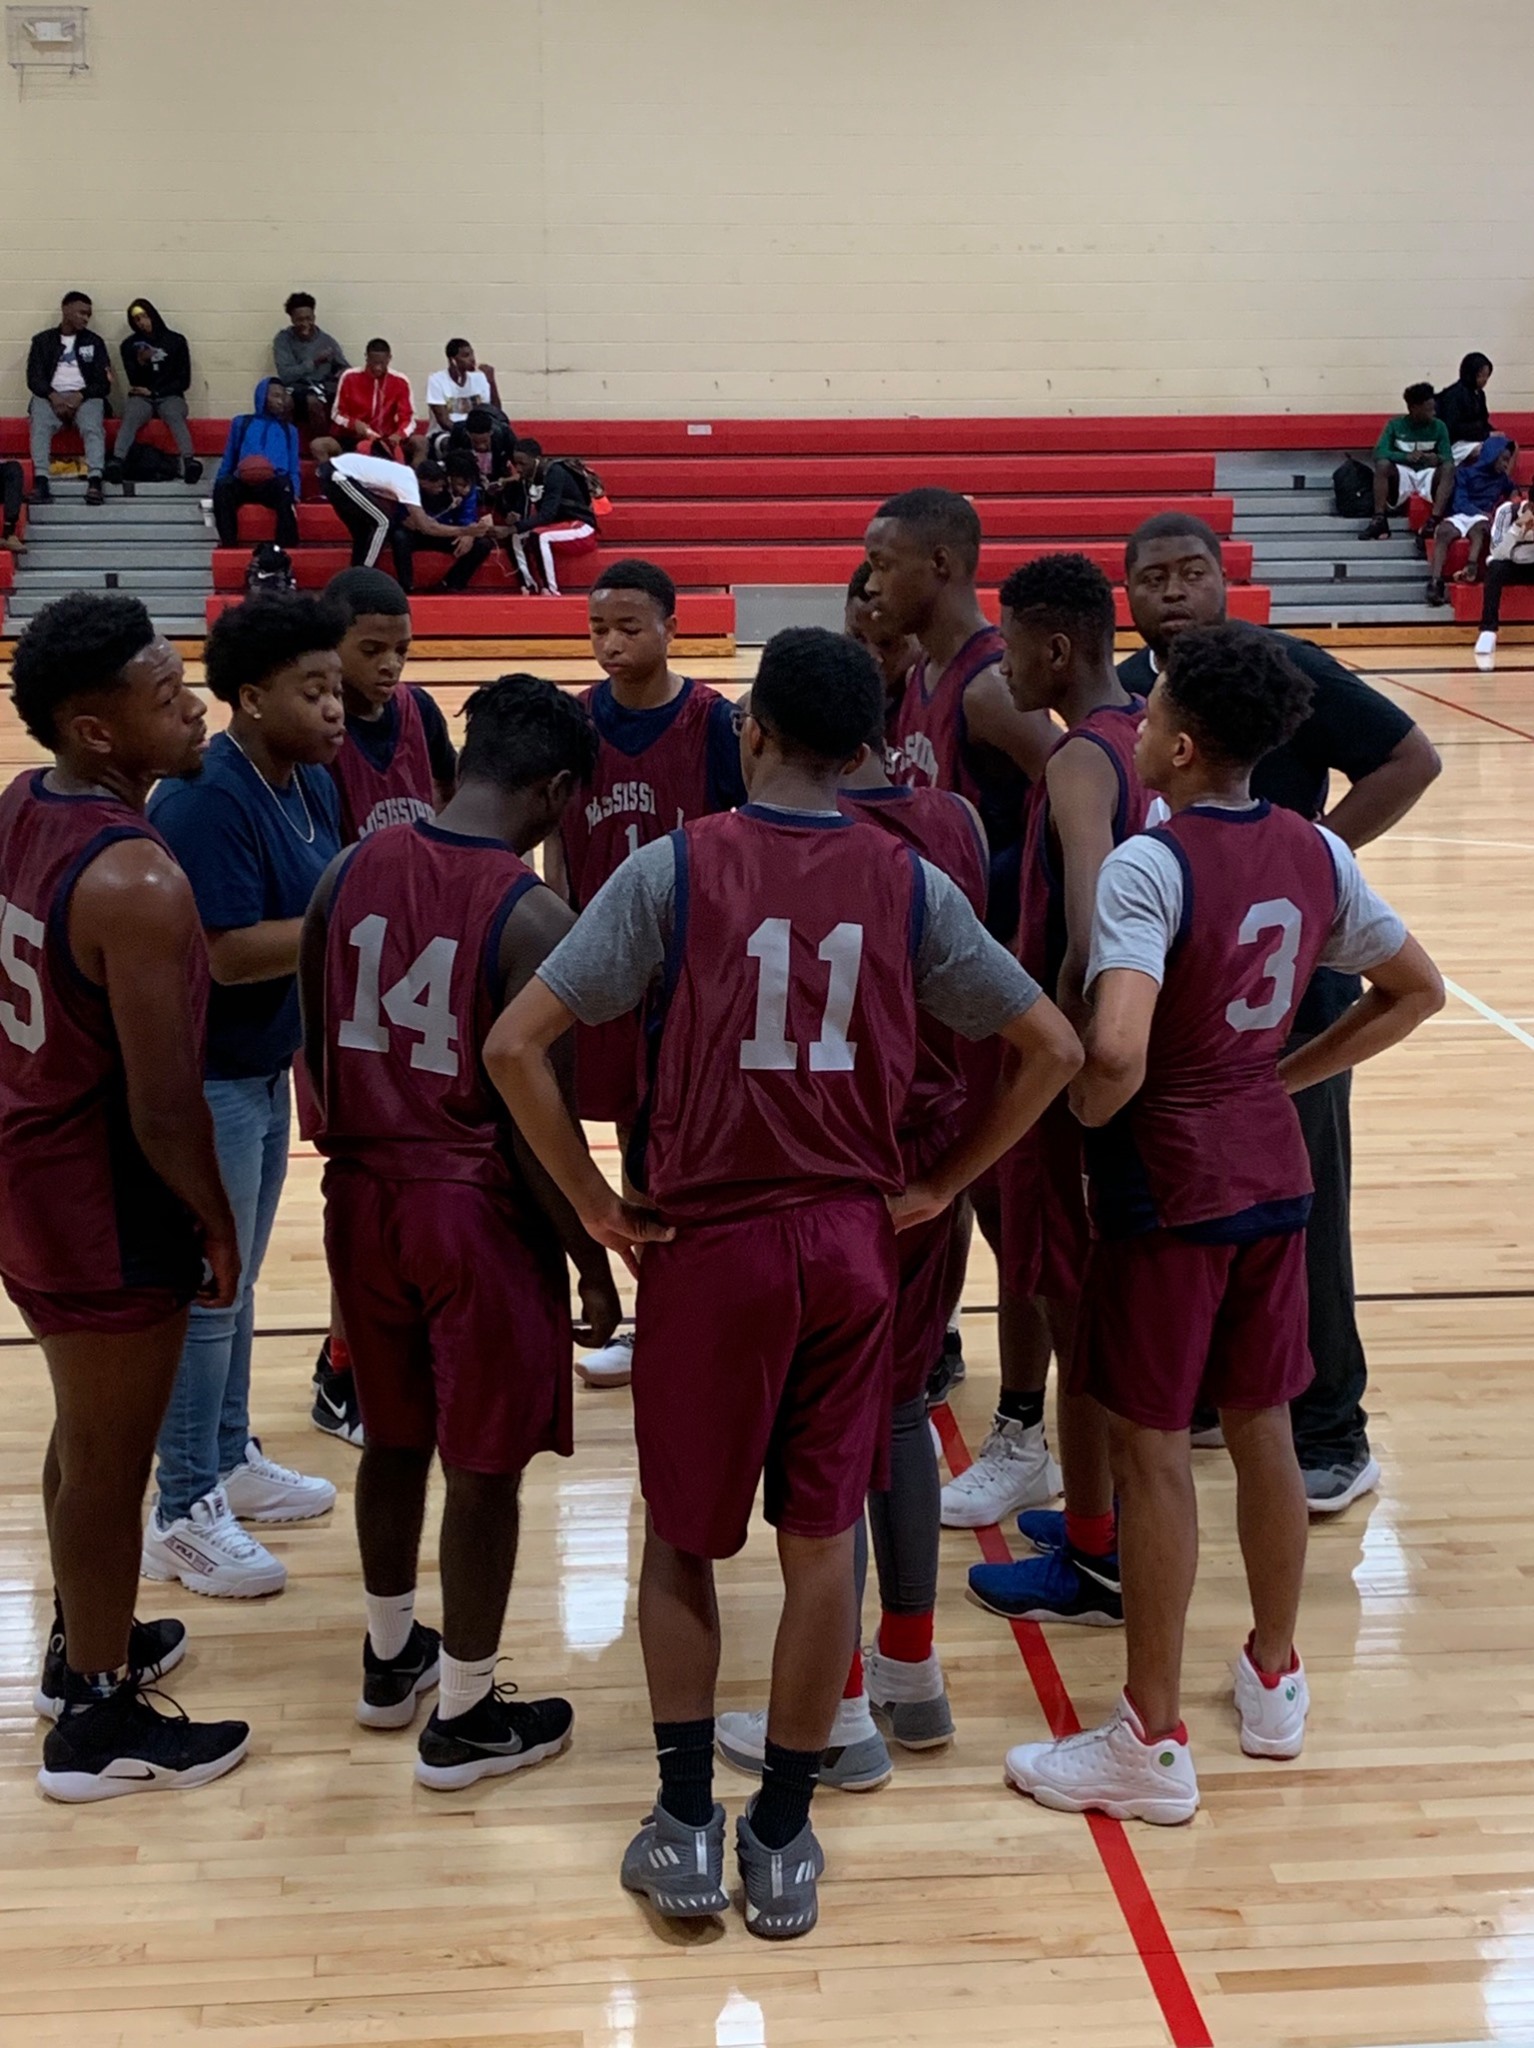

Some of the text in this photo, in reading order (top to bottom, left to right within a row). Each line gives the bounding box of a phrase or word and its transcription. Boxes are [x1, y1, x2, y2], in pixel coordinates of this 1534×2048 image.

[0, 894, 46, 1054] 5
[338, 913, 459, 1077] 14
[739, 917, 863, 1071] 11
[1225, 897, 1302, 1032] 3
